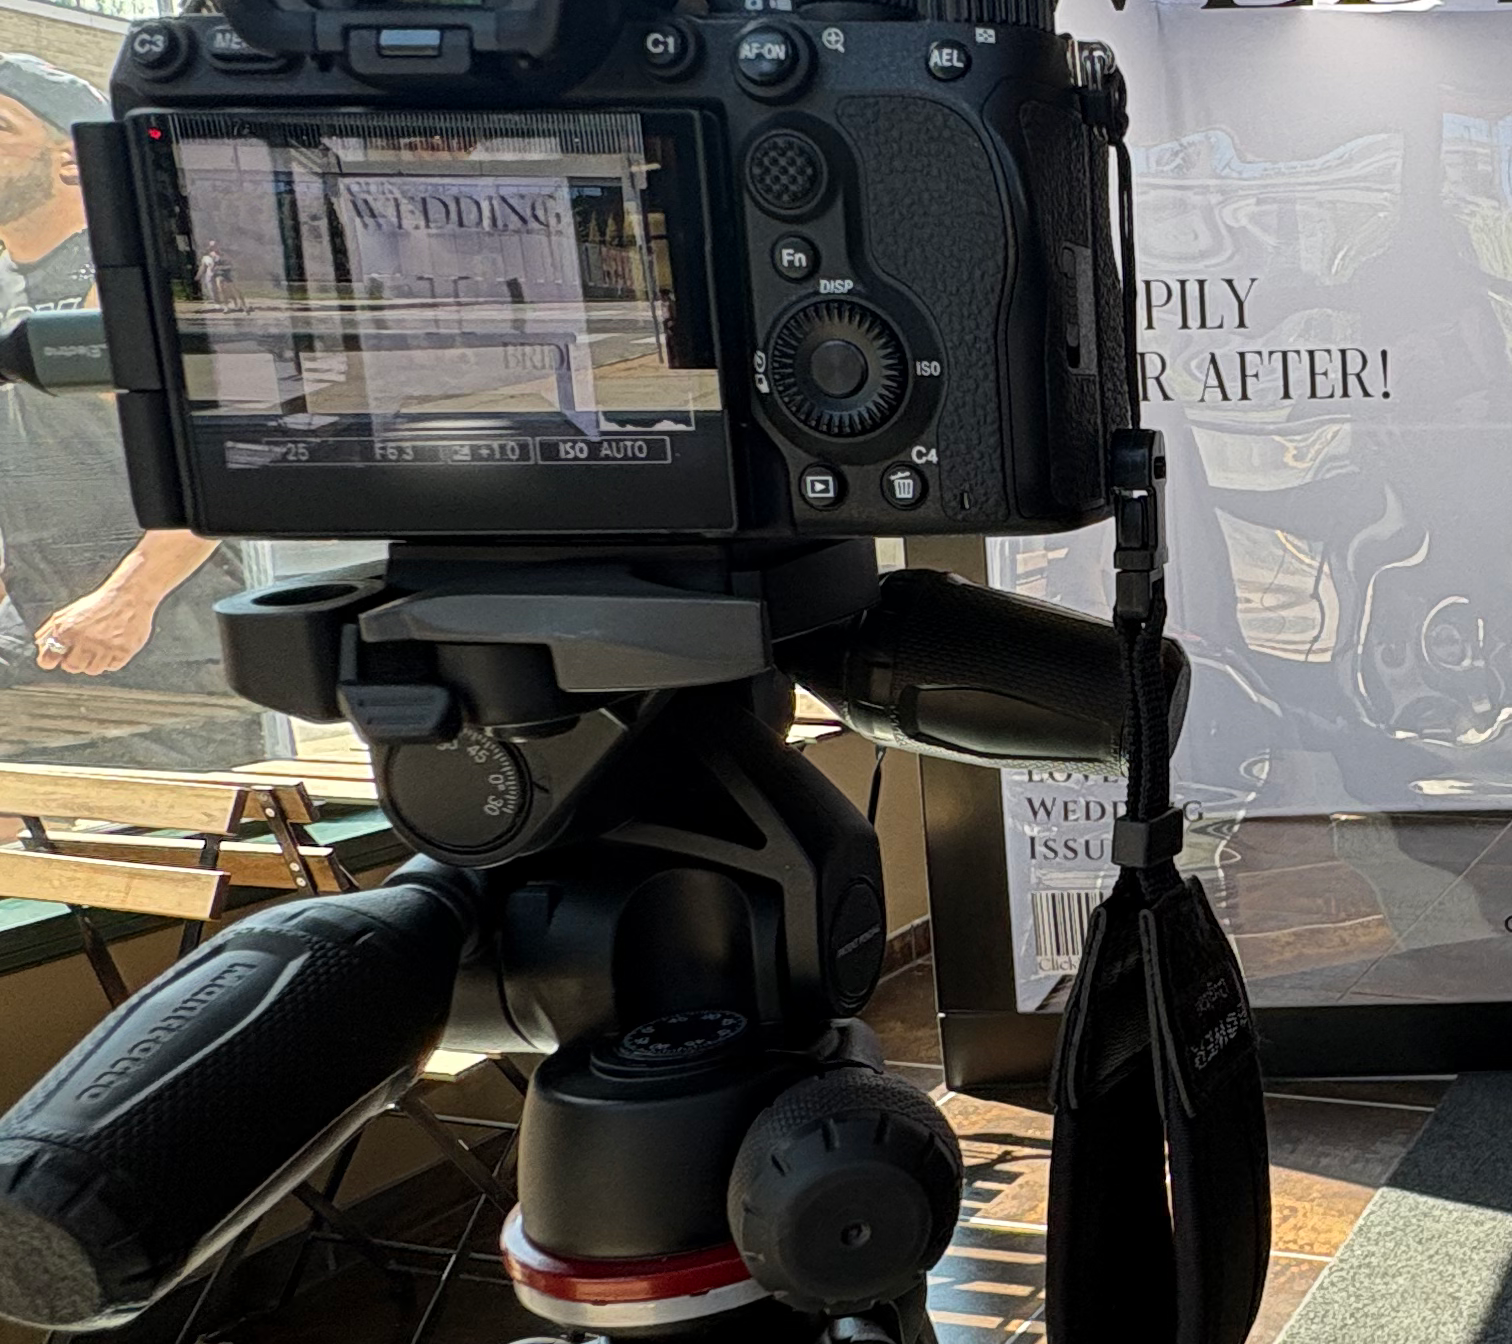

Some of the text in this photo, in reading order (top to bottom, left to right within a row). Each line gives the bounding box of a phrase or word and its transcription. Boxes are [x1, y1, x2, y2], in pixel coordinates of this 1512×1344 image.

[133, 32, 166, 54] C3
[213, 32, 246, 50] ME
[645, 34, 675, 54] C1
[929, 47, 963, 68] AEL
[781, 249, 807, 268] Fn
[820, 279, 854, 294] DISP
[1141, 278, 1259, 331] PILY
[916, 360, 942, 378] ISO
[1198, 347, 1391, 402] AFTER!
[559, 440, 648, 459] ISO AUTO
[911, 446, 939, 466] C4
[466, 745, 490, 764] 45
[1028, 836, 1105, 862] ISSU
